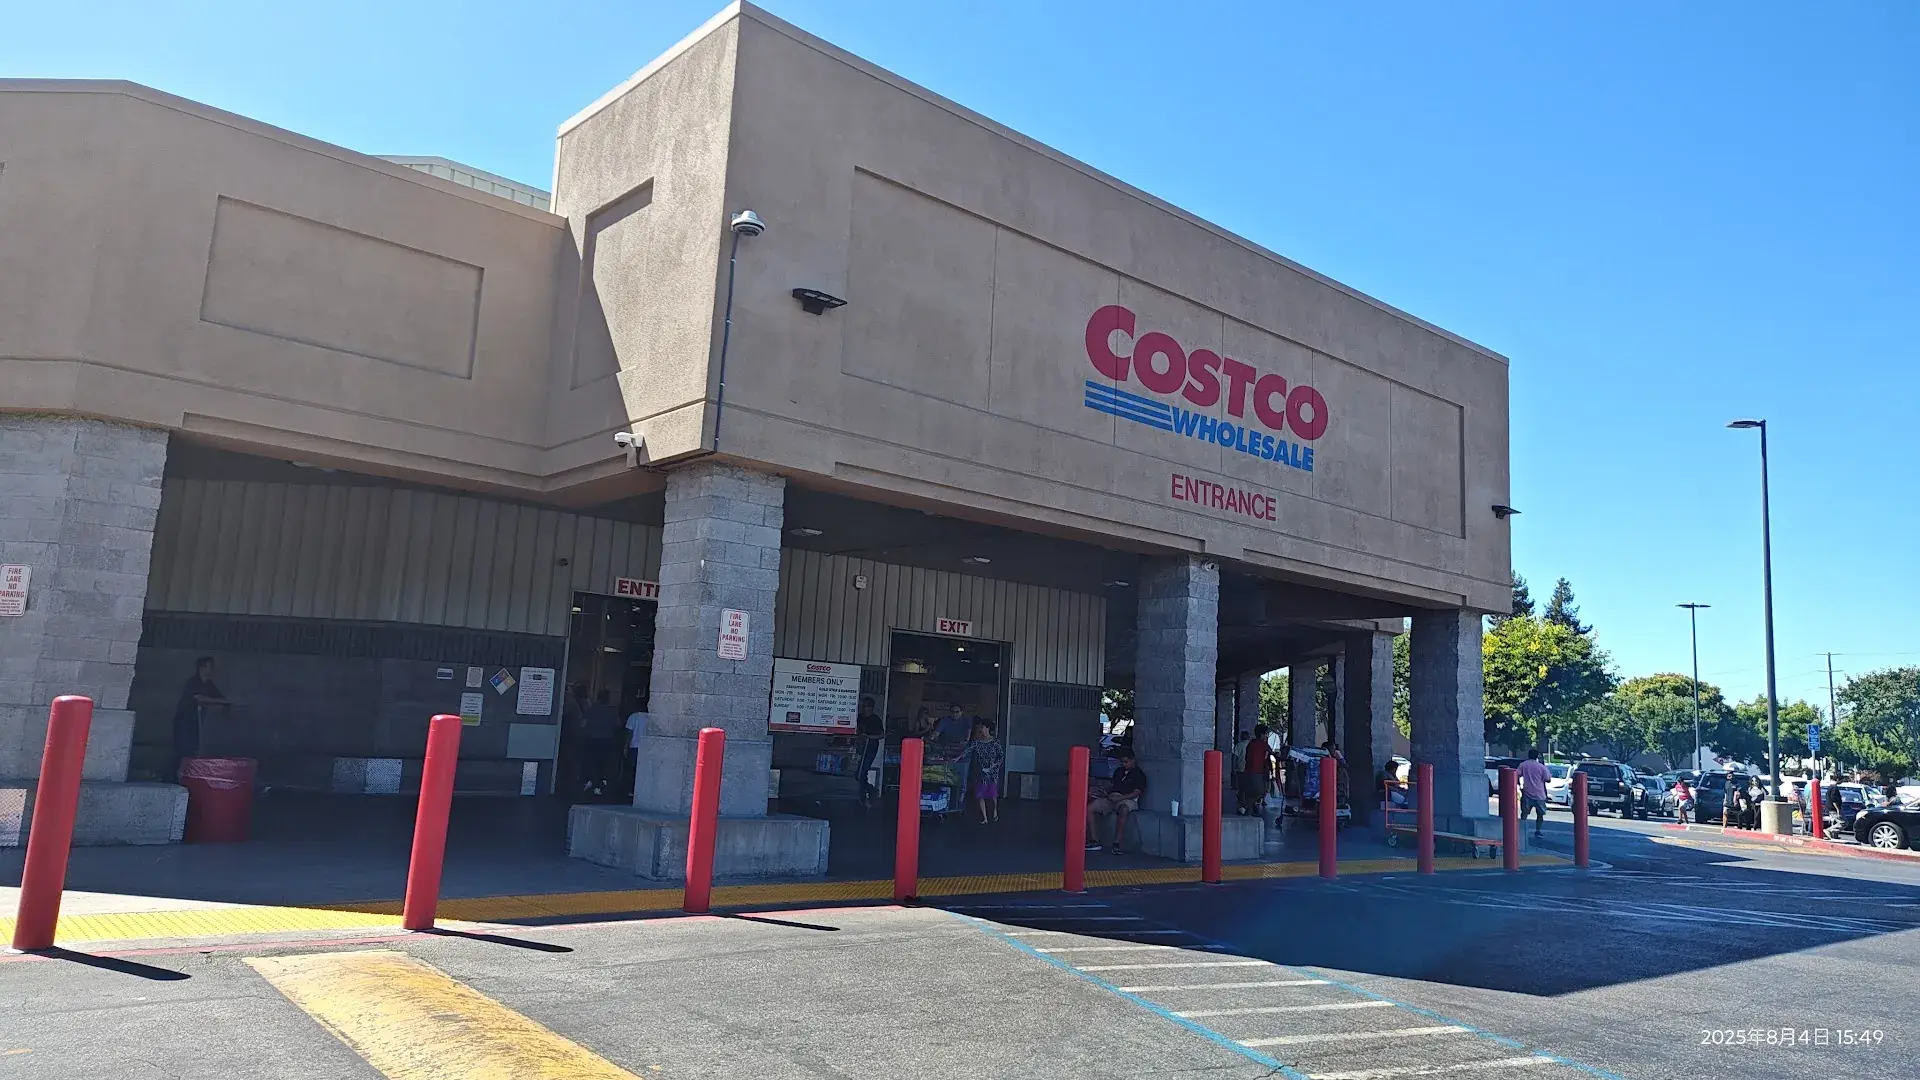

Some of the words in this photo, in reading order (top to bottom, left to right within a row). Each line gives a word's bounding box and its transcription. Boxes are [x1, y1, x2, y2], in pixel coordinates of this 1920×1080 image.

[1085, 304, 1329, 441] COSTCO
[1171, 406, 1315, 473] WHOLESALE
[1171, 473, 1277, 521] ENTRANCE
[8, 567, 22, 575] FIRE
[6, 575, 22, 583] LANE
[729, 612, 743, 621] FIRE
[728, 620, 742, 628] LANE
[940, 619, 969, 634] EXIT
[721, 634, 746, 643] PARKING
[806, 663, 832, 671] COSTCO
[791, 675, 825, 685] MEMBERS
[826, 678, 844, 686] ONLY
